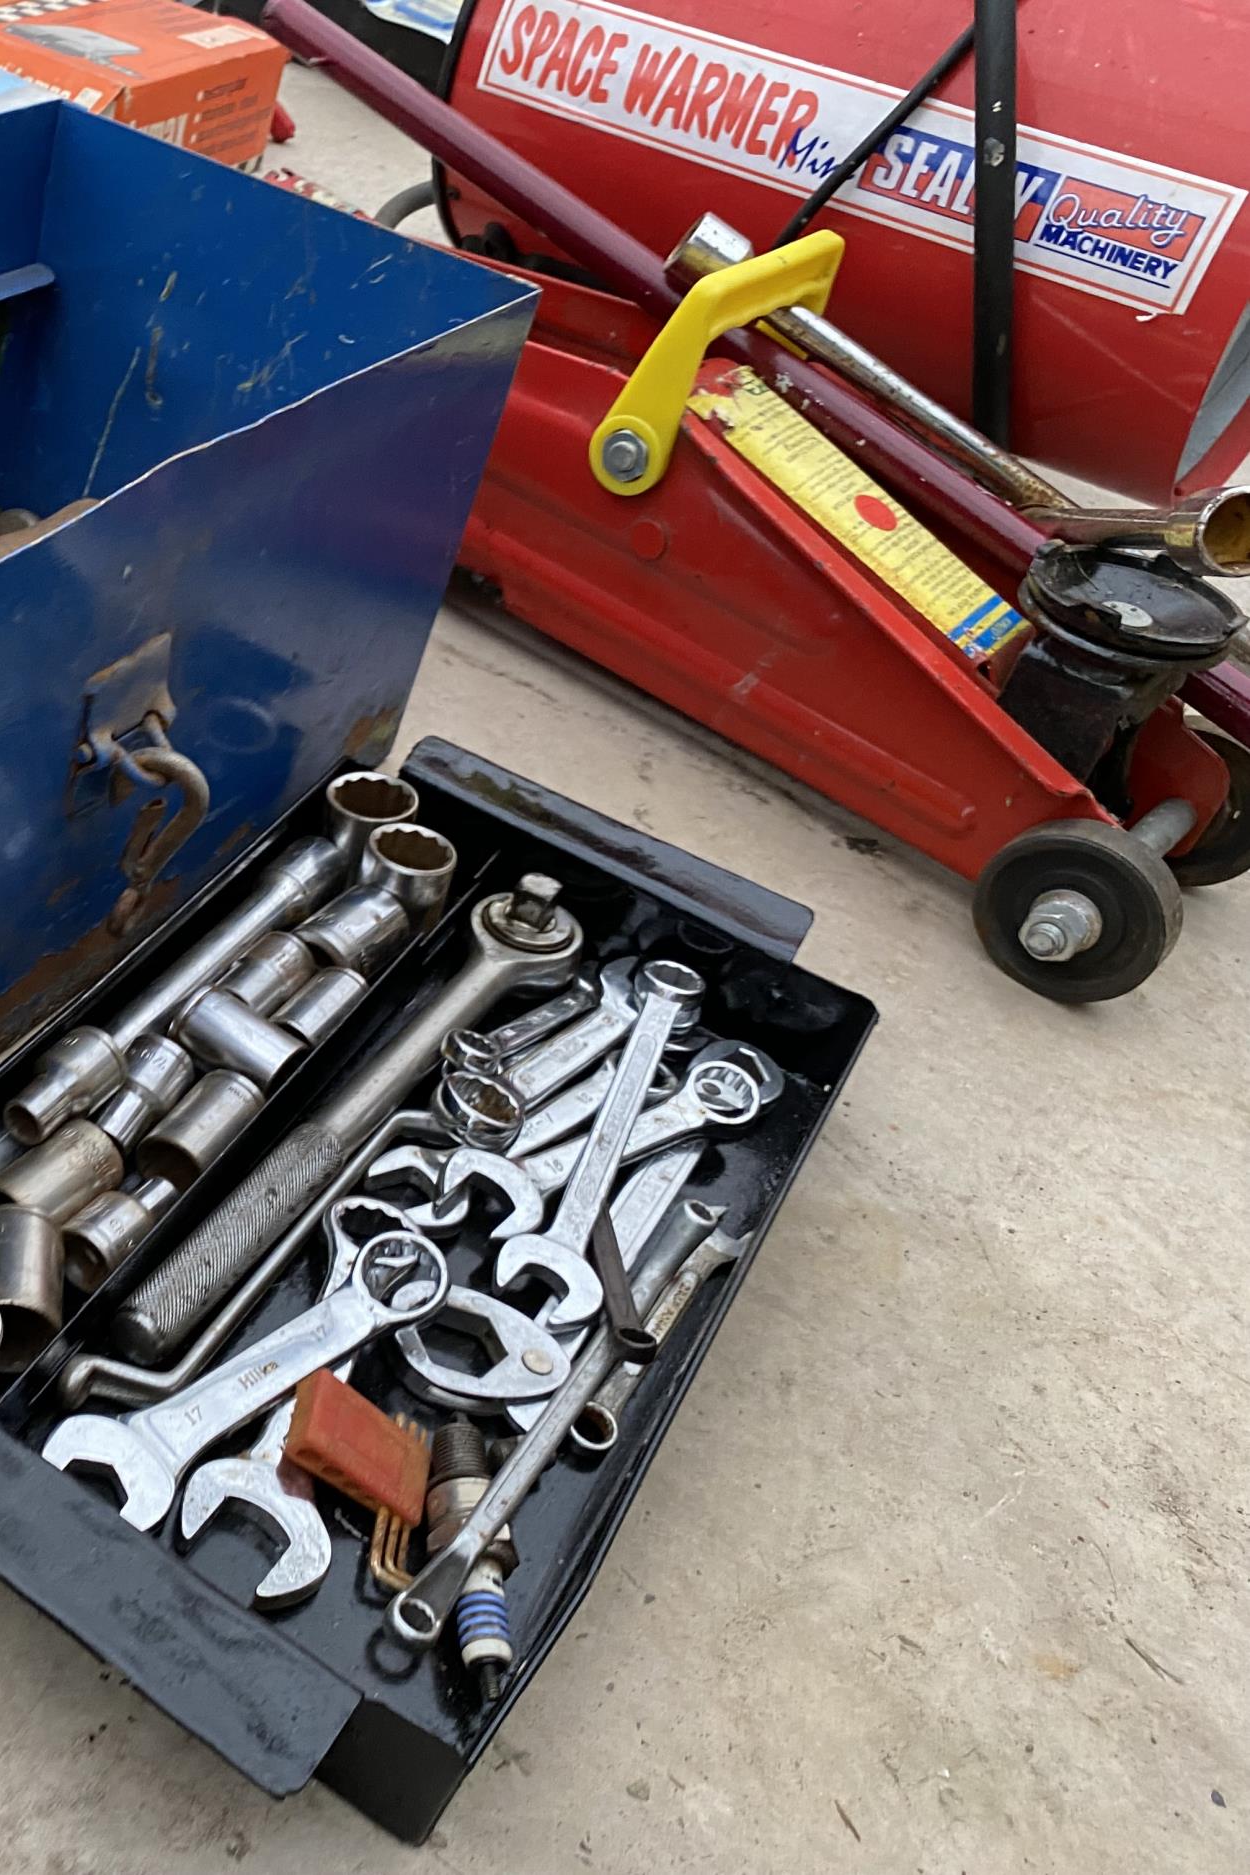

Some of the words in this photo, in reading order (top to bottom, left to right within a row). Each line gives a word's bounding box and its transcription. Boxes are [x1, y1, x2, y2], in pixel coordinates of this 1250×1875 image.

[500, 4, 629, 104] SPACE
[624, 43, 819, 168] WARMER
[777, 127, 855, 179] Min
[871, 133, 1047, 219] SEALY
[1038, 222, 1180, 281] MACHINERY
[1049, 194, 1192, 248] Quality
